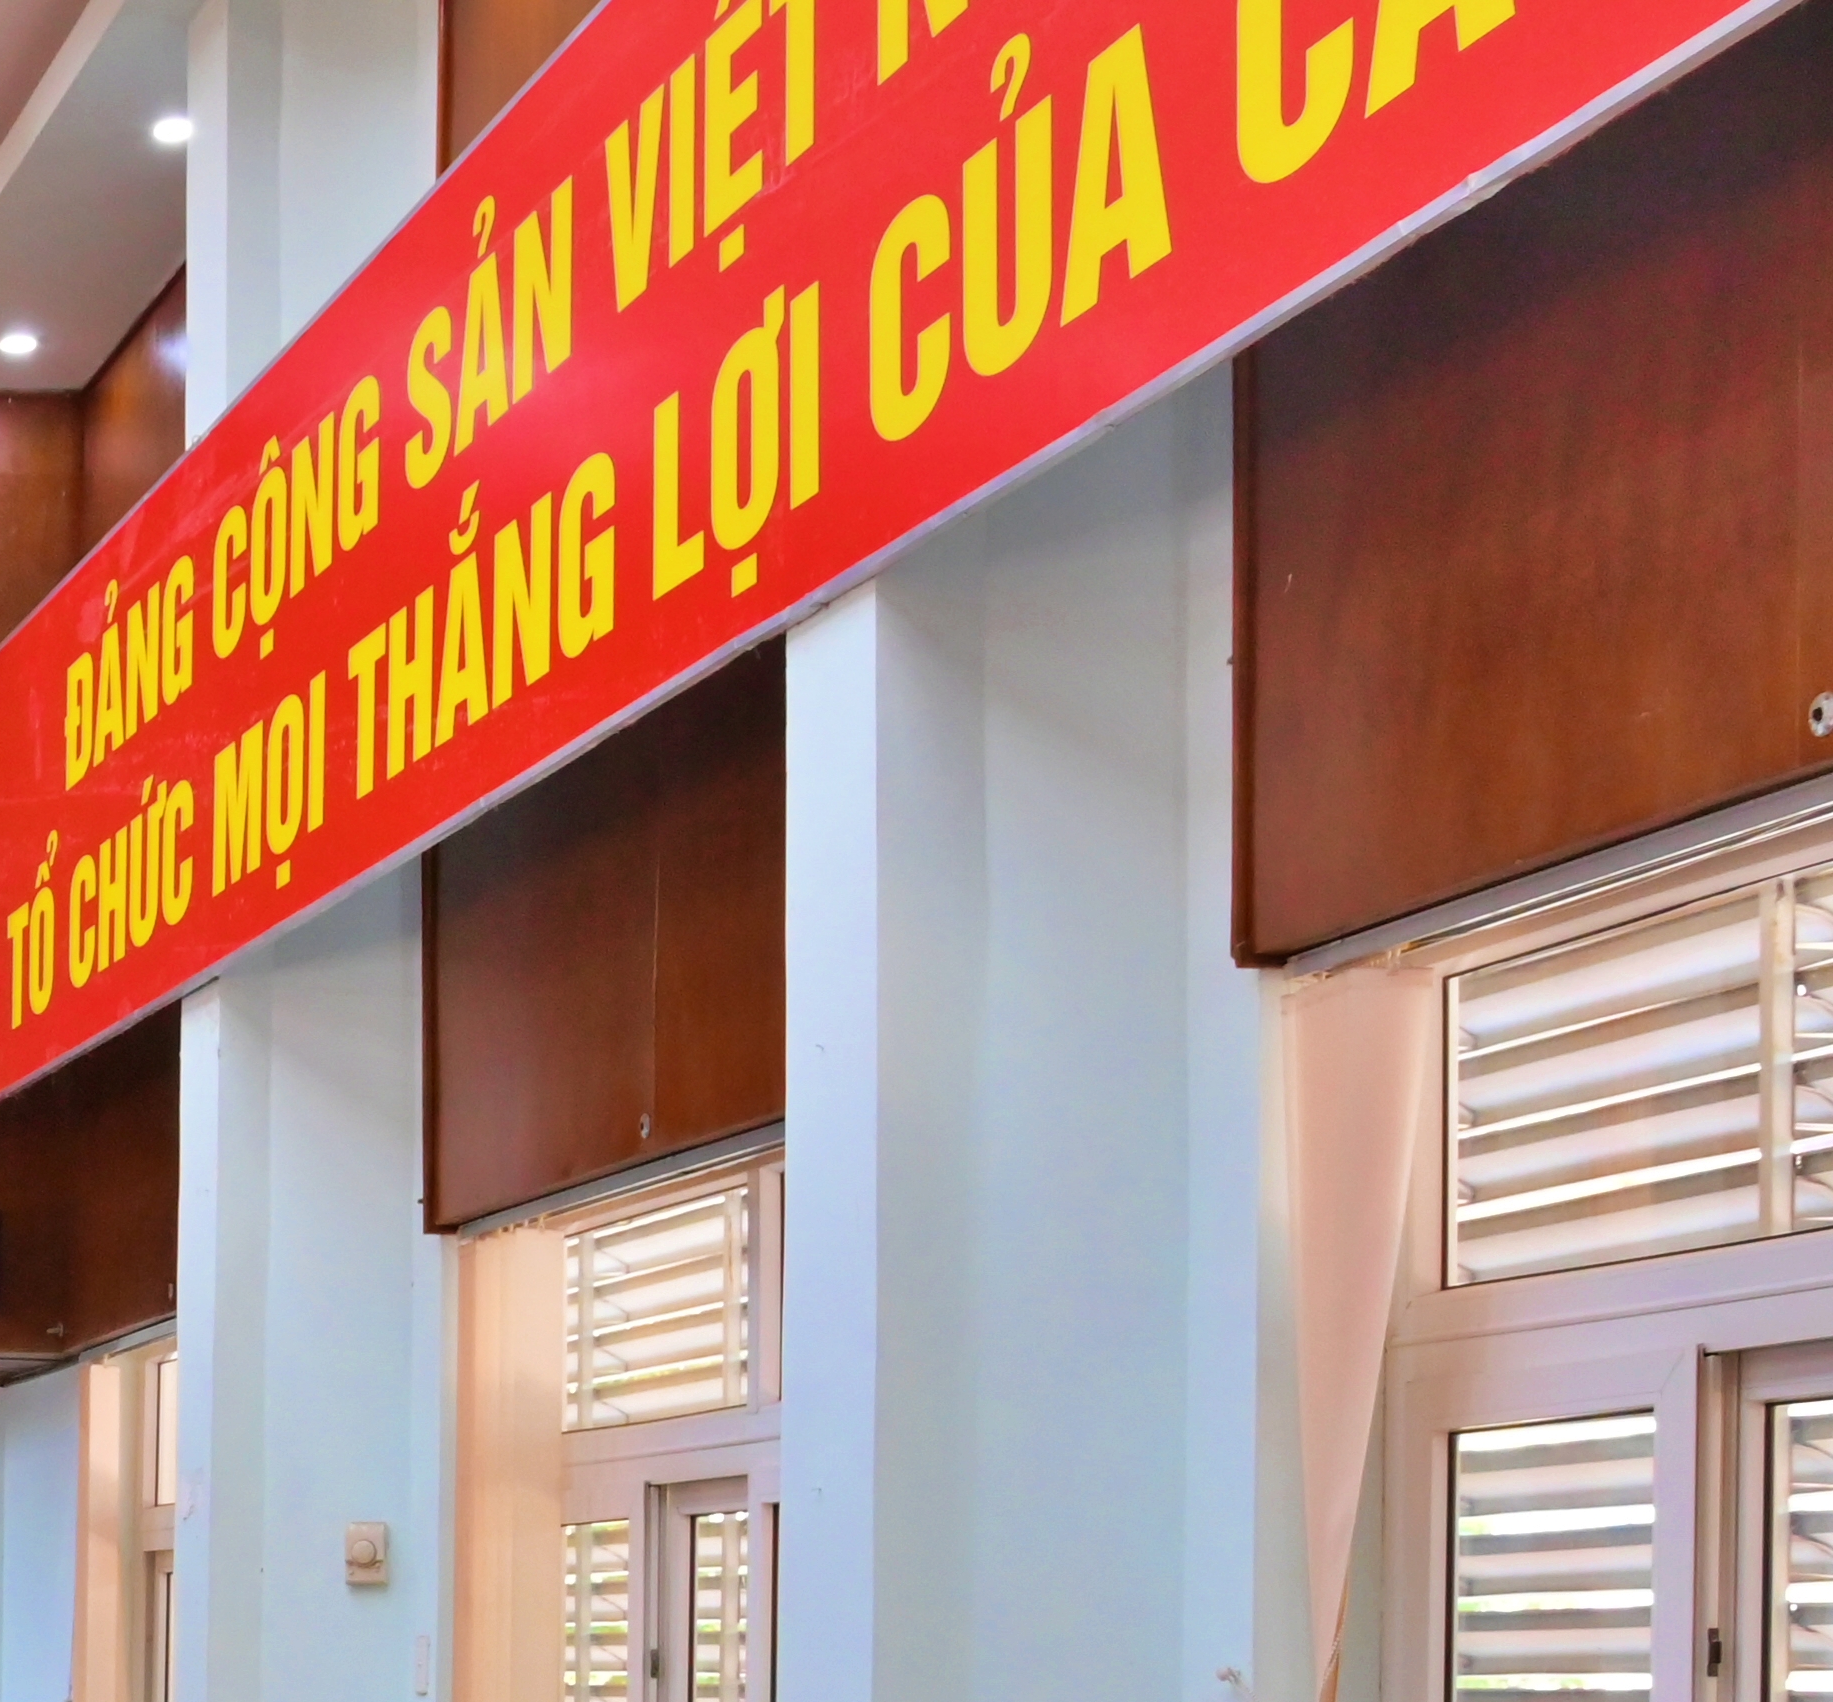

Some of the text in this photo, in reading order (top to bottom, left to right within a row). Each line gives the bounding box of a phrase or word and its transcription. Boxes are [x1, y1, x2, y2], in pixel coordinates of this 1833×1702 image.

[7, 829, 59, 1029] TỔ
[68, 774, 194, 988] CHỨC
[212, 669, 326, 897] MỌI
[348, 452, 615, 800] THẮNG
[653, 281, 820, 601] LỢI
[869, 23, 1172, 441] CỦA
[65, 0, 815, 791] ĐẢNG CỘNG SẢN VIỆT
